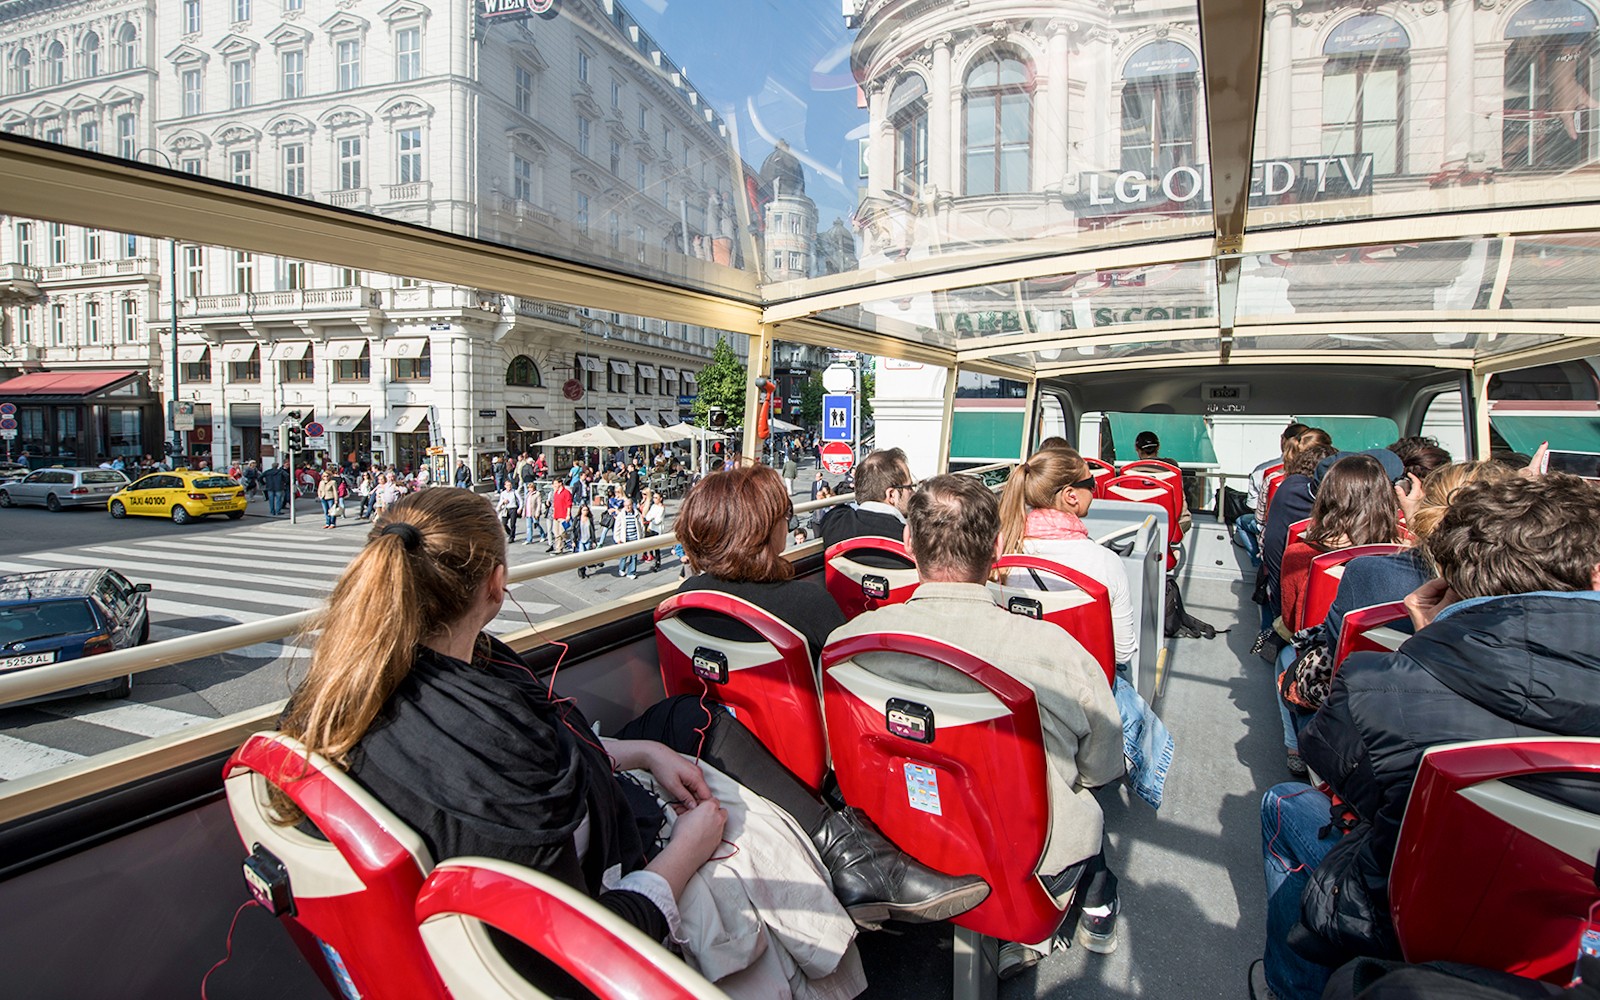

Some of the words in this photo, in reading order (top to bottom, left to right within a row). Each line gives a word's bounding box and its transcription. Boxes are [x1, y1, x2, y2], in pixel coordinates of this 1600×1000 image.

[485, 0, 525, 13] WIEN
[1514, 19, 1536, 27] AIR
[1538, 15, 1586, 23] FRANCE
[1089, 170, 1147, 206] LG
[1306, 155, 1373, 193] TV
[1263, 207, 1361, 224] DISPLAY
[130, 497, 144, 506] TAXI
[144, 496, 166, 505] 40100
[6, 655, 33, 668] 5253
[36, 654, 49, 663] AL
